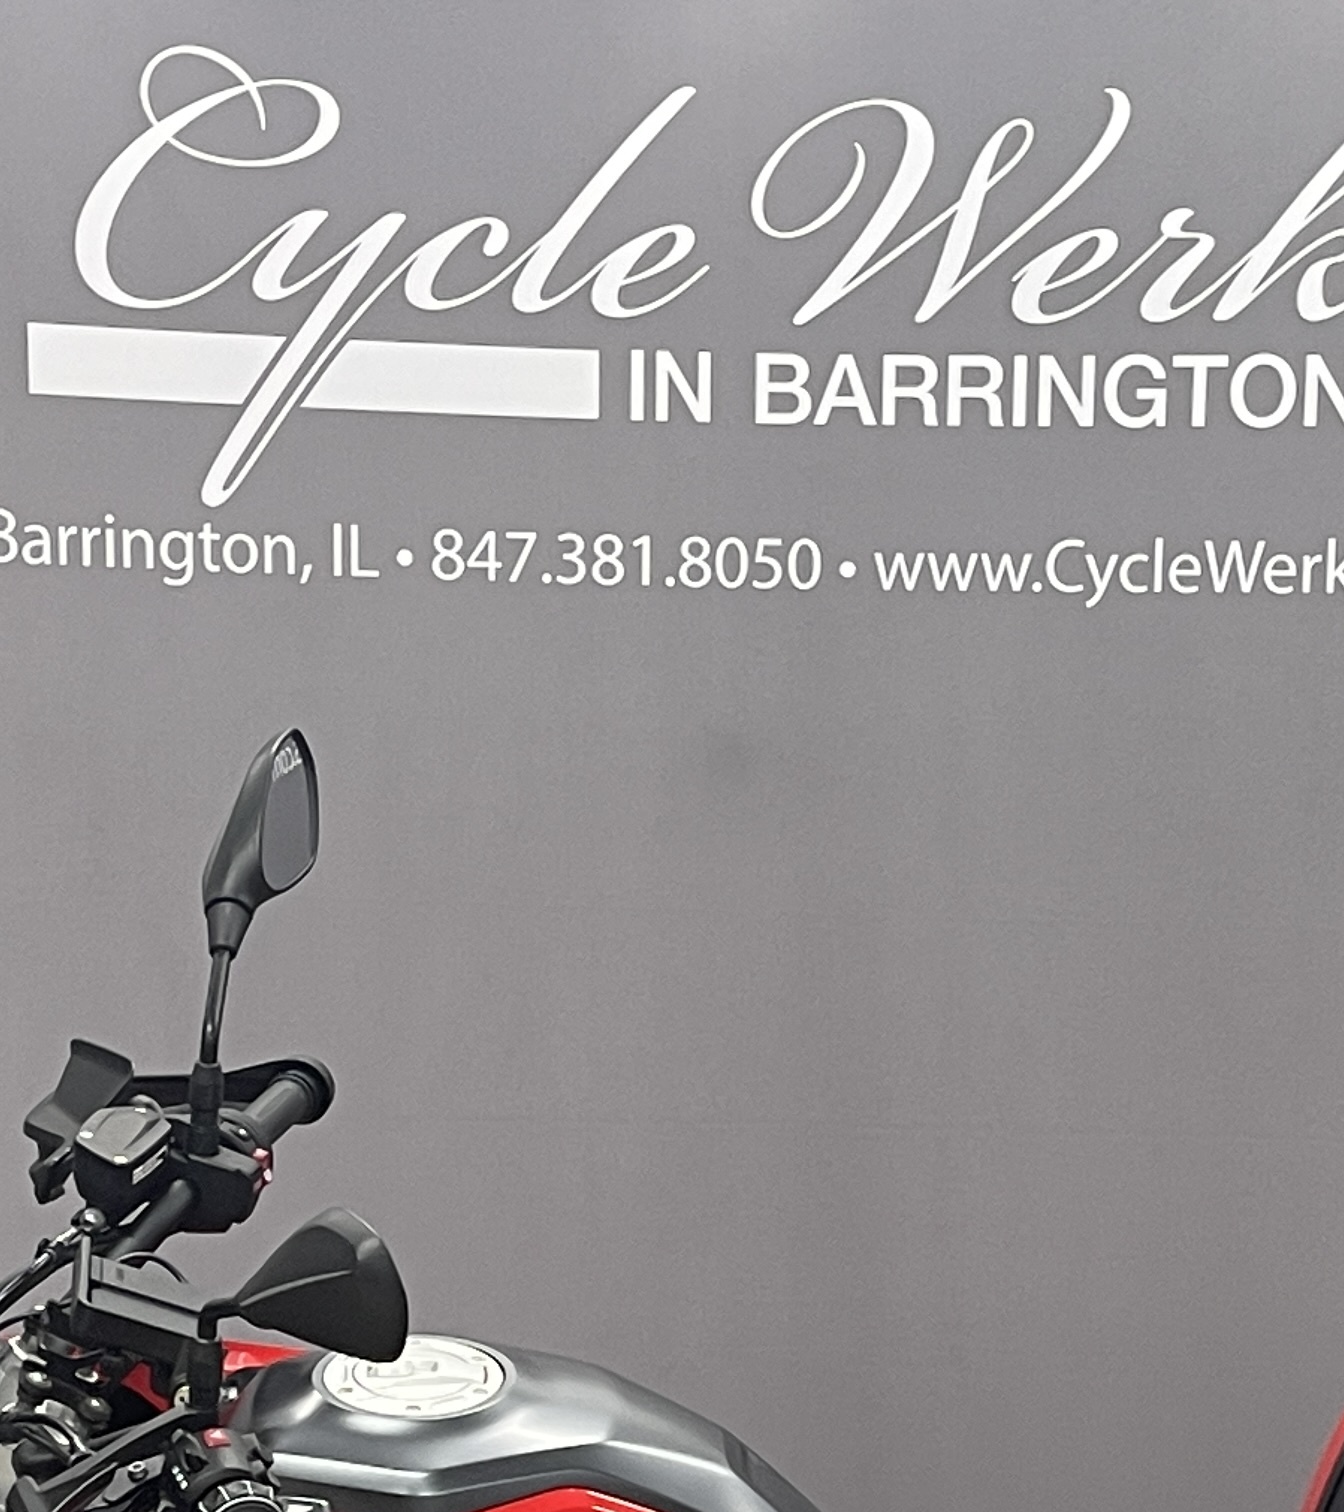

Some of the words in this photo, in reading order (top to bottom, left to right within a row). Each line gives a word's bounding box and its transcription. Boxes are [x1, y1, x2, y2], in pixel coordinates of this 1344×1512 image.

[73, 43, 712, 509] Cycle
[628, 348, 713, 425] IN
[332, 521, 381, 579] IL
[430, 527, 823, 591] 847.381.8050
